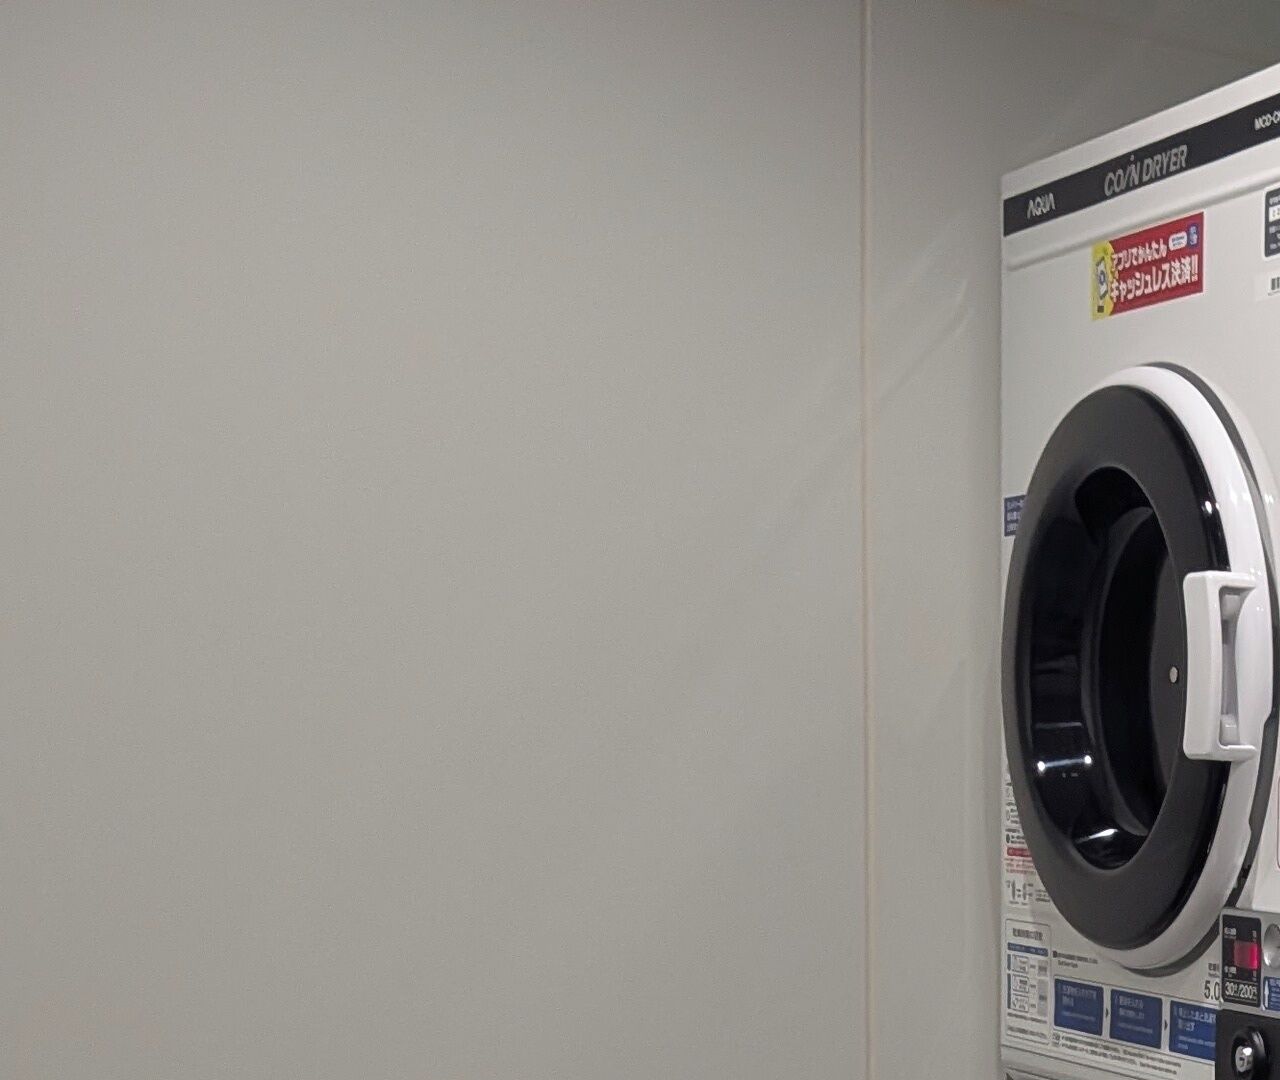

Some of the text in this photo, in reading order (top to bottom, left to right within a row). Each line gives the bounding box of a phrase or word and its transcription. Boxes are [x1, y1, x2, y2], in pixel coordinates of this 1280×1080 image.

[1142, 145, 1188, 181] DRYER
[1111, 239, 1168, 271] アプリでかんたん
